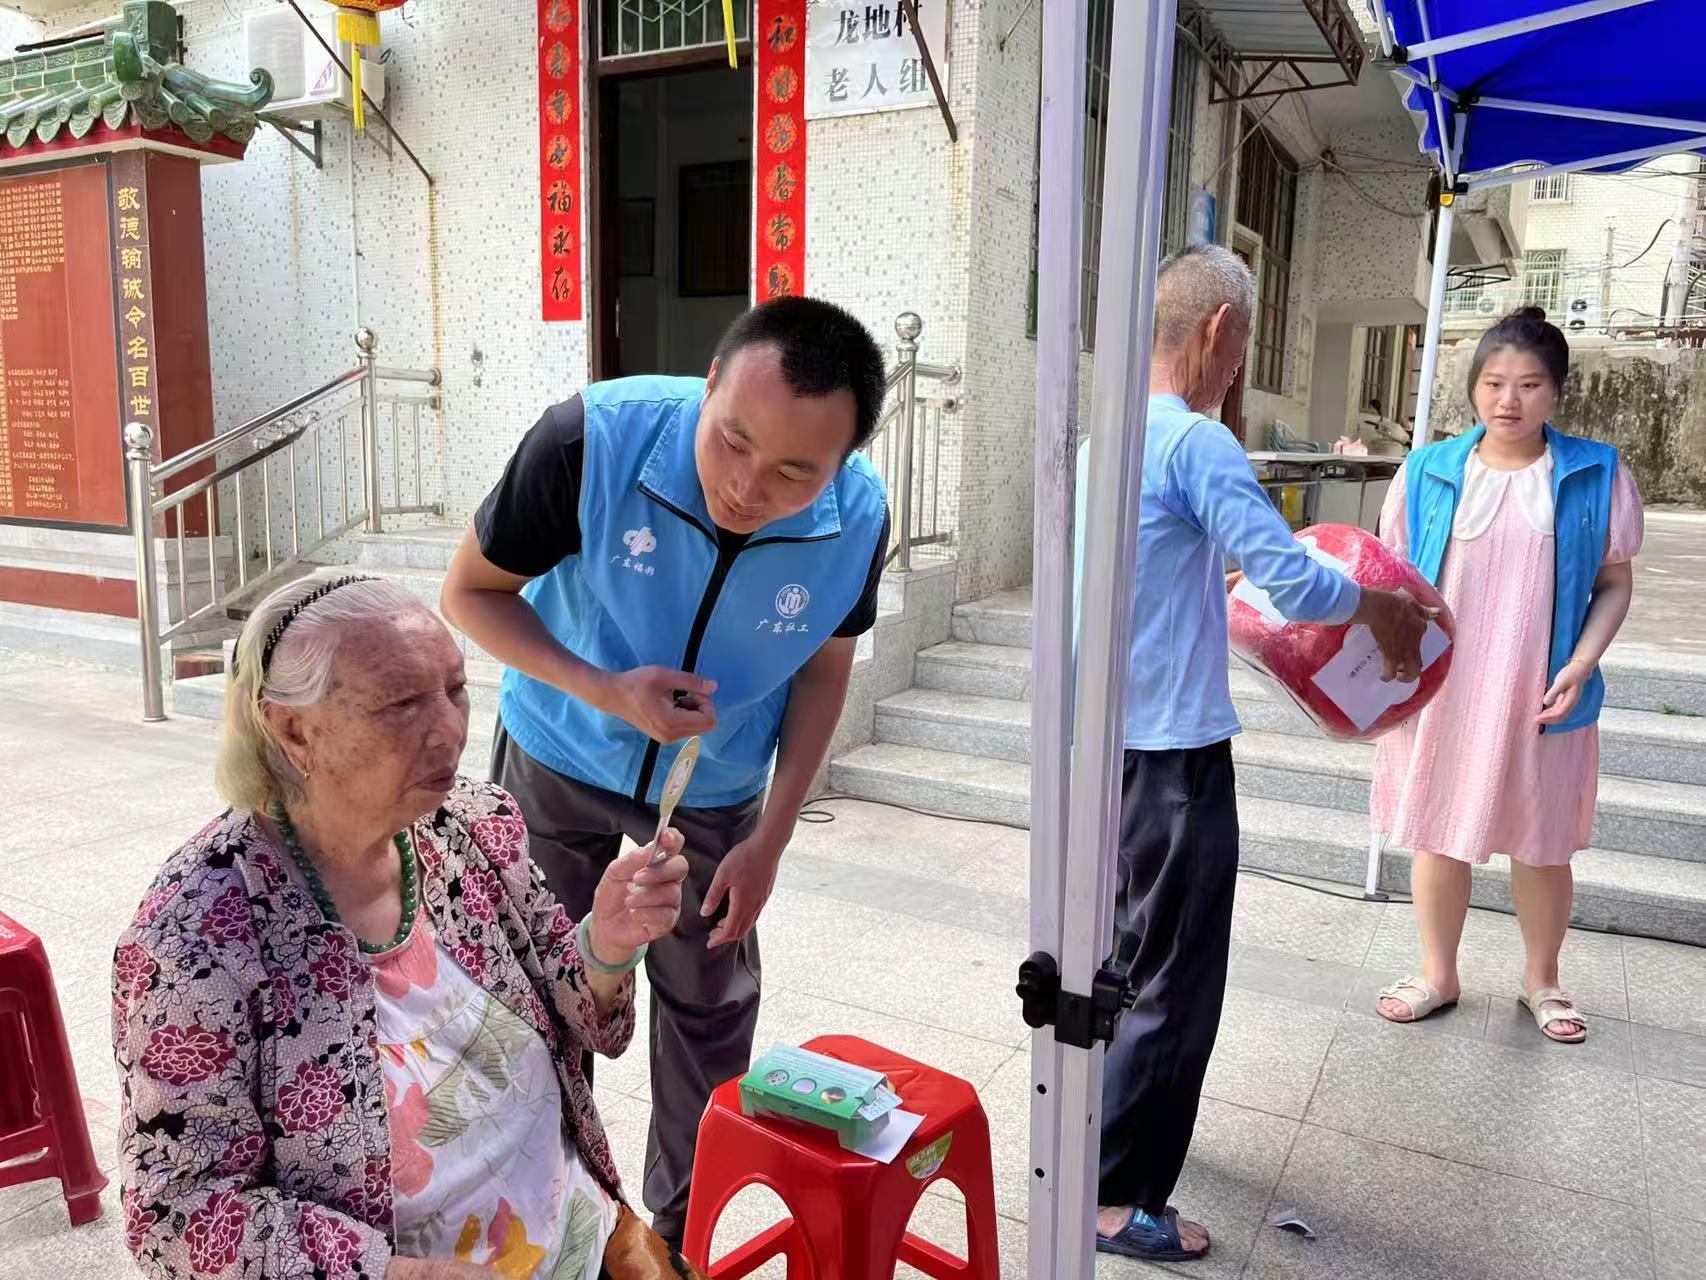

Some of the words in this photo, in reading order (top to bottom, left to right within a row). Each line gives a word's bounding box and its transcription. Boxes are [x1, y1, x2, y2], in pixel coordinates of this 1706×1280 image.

[824, 57, 928, 102] 老人组
[754, 618, 809, 634] 广东社工
